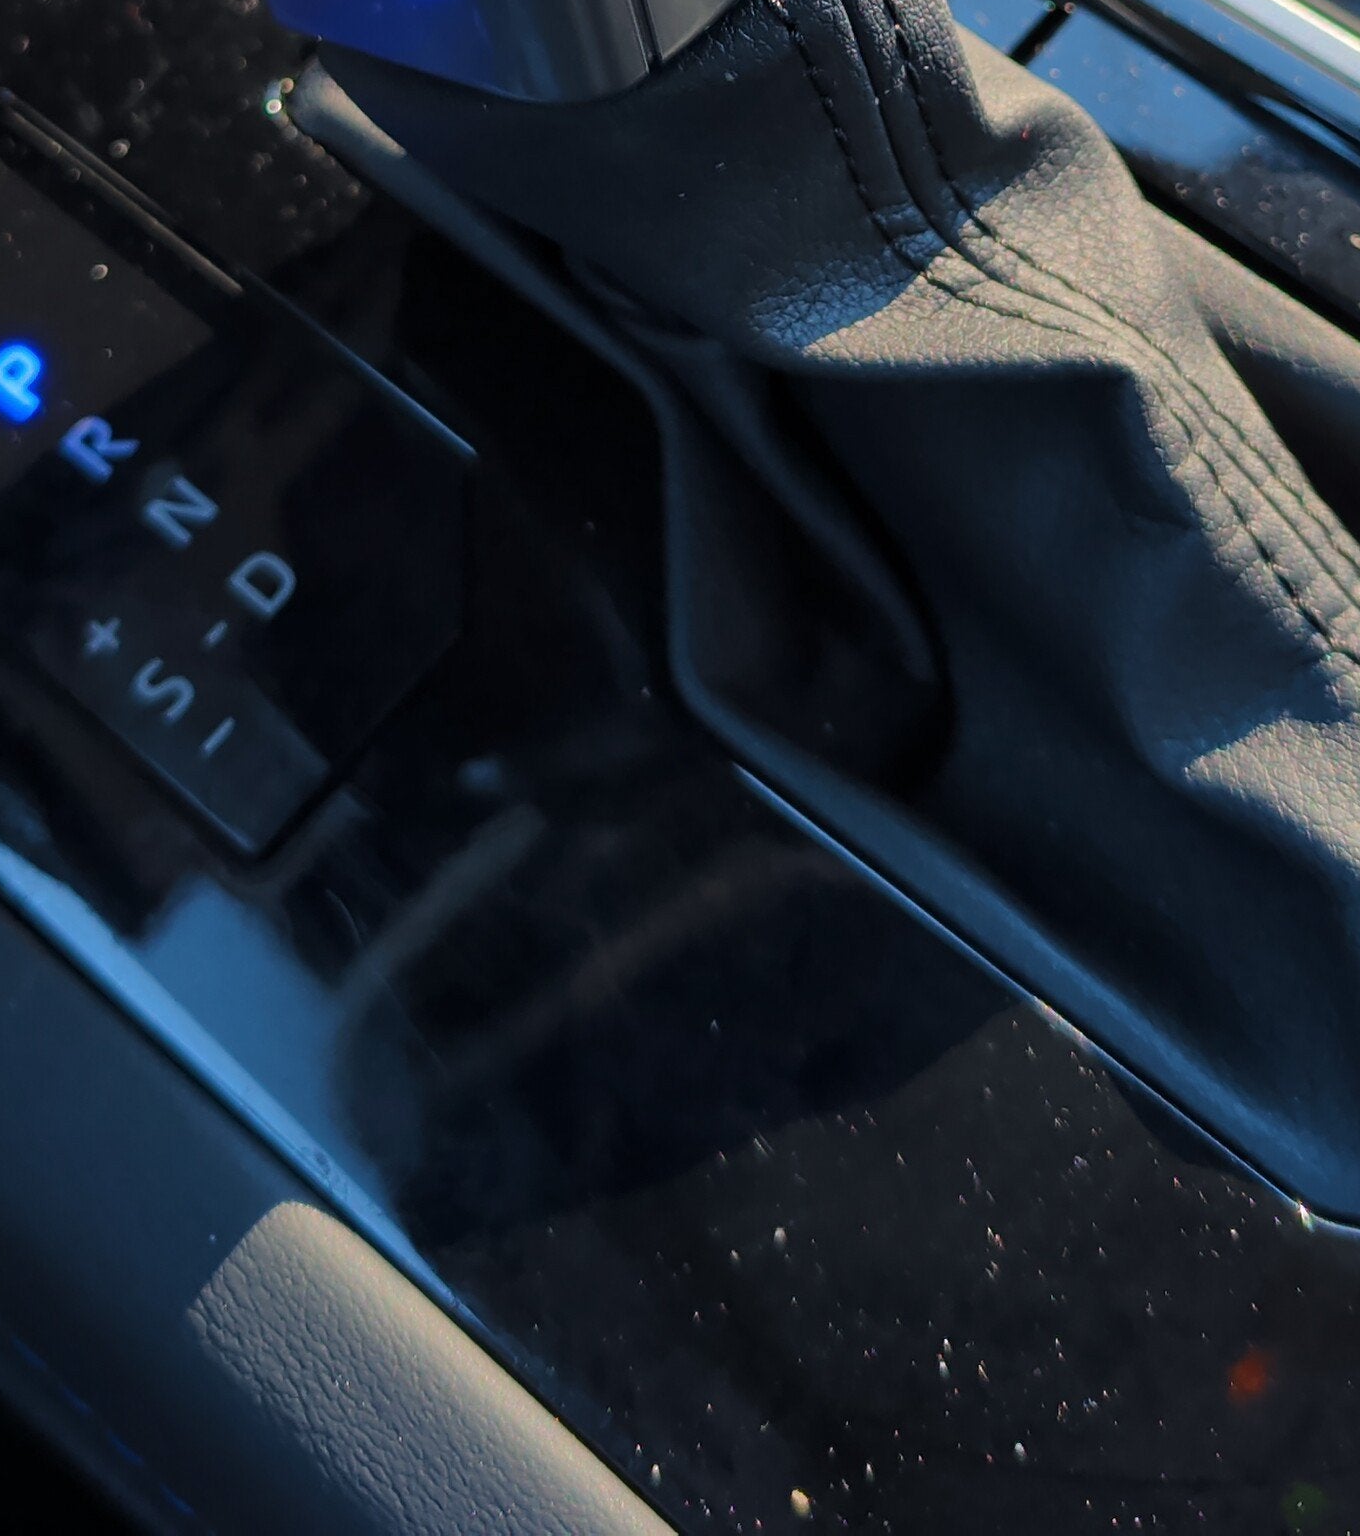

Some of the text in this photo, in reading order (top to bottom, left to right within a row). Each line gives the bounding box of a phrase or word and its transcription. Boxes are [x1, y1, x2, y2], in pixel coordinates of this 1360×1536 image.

[58, 415, 139, 483] R
[145, 475, 219, 547] N
[228, 551, 297, 618] D
[133, 658, 196, 725] S
